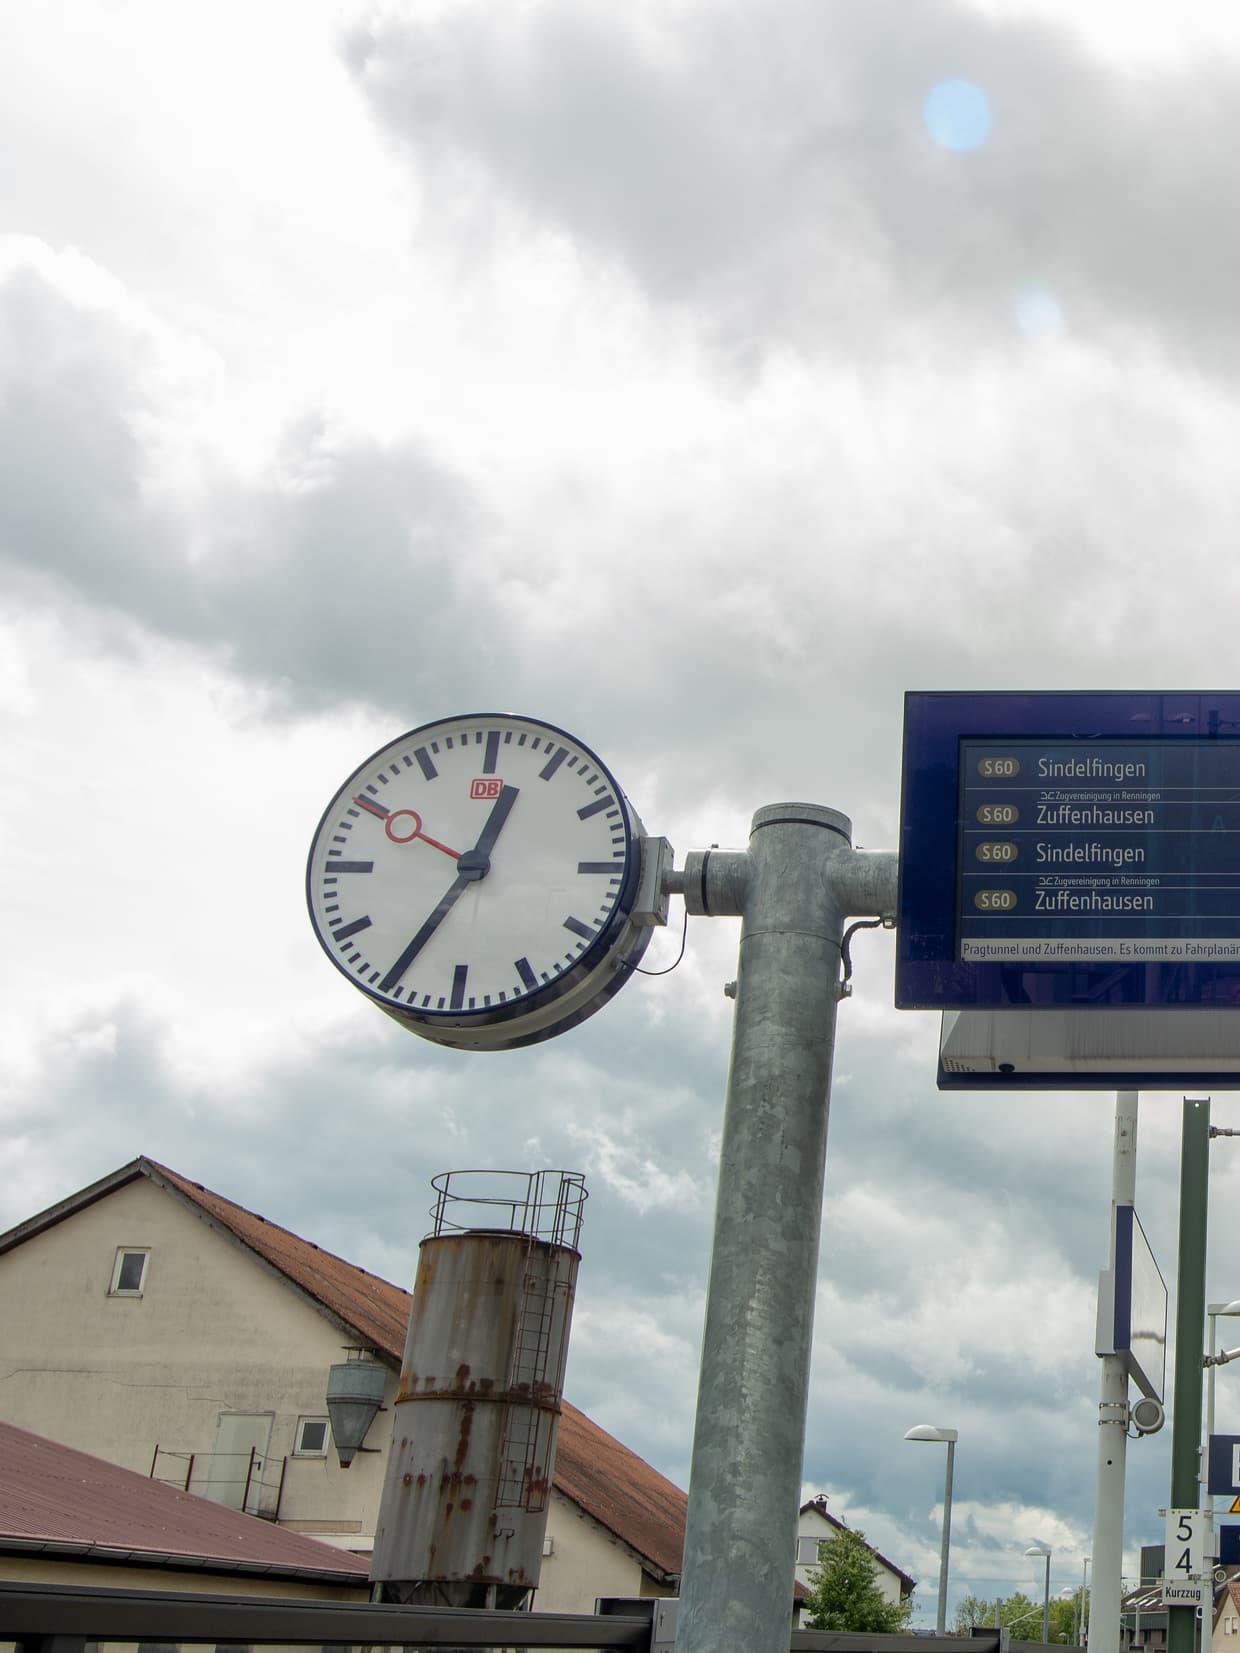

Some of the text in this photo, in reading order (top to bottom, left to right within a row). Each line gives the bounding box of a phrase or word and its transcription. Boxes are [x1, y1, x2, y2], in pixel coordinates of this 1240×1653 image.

[1038, 758, 1146, 782] Sindelfingen
[475, 782, 498, 796] DB
[1055, 791, 1161, 802] Zugvereinigung in Renningen
[1036, 805, 1155, 824] Zuffenhausen
[1036, 842, 1145, 867] Sindelfingen
[1054, 876, 1160, 887] Zugvereinigung in Renningen
[1035, 890, 1154, 910] Zuffenhausen
[963, 943, 1019, 957] Pragtunnel
[1022, 943, 1041, 955] und
[1044, 943, 1117, 955] Zuffenhausen.
[1120, 943, 1131, 955] Es
[1134, 943, 1168, 955] kommt
[1170, 946, 1182, 955] zu
[1176, 1515, 1193, 1541] 5
[1176, 1548, 1192, 1573] 4
[1165, 1586, 1201, 1601] Kurzzug
